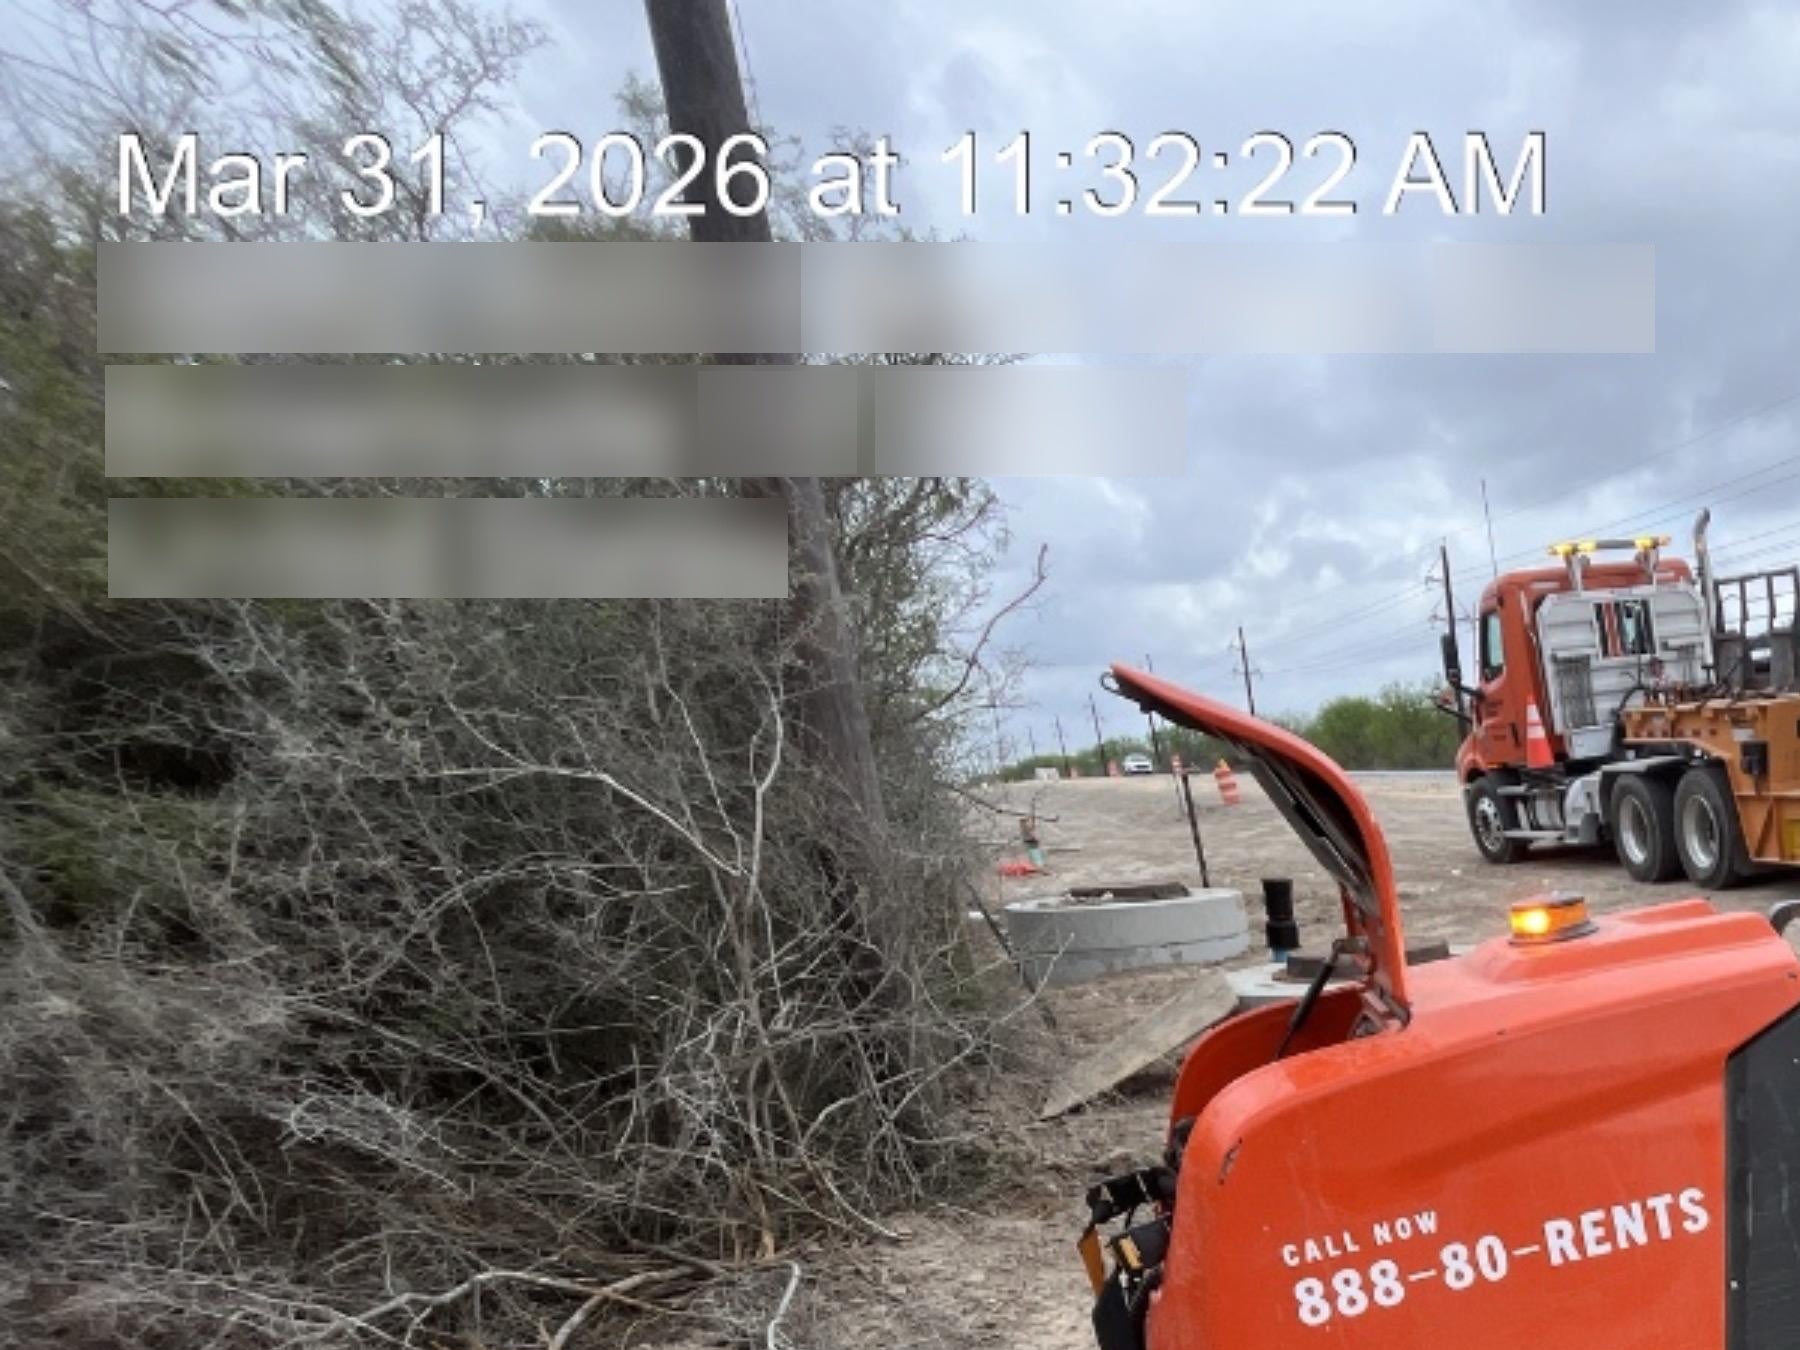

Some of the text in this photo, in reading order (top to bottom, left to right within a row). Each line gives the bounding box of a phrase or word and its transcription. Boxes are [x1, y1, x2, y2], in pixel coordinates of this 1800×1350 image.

[1282, 1210, 1439, 1267] CALL NOW
[1293, 1186, 1710, 1327] 888-80-RENTS
